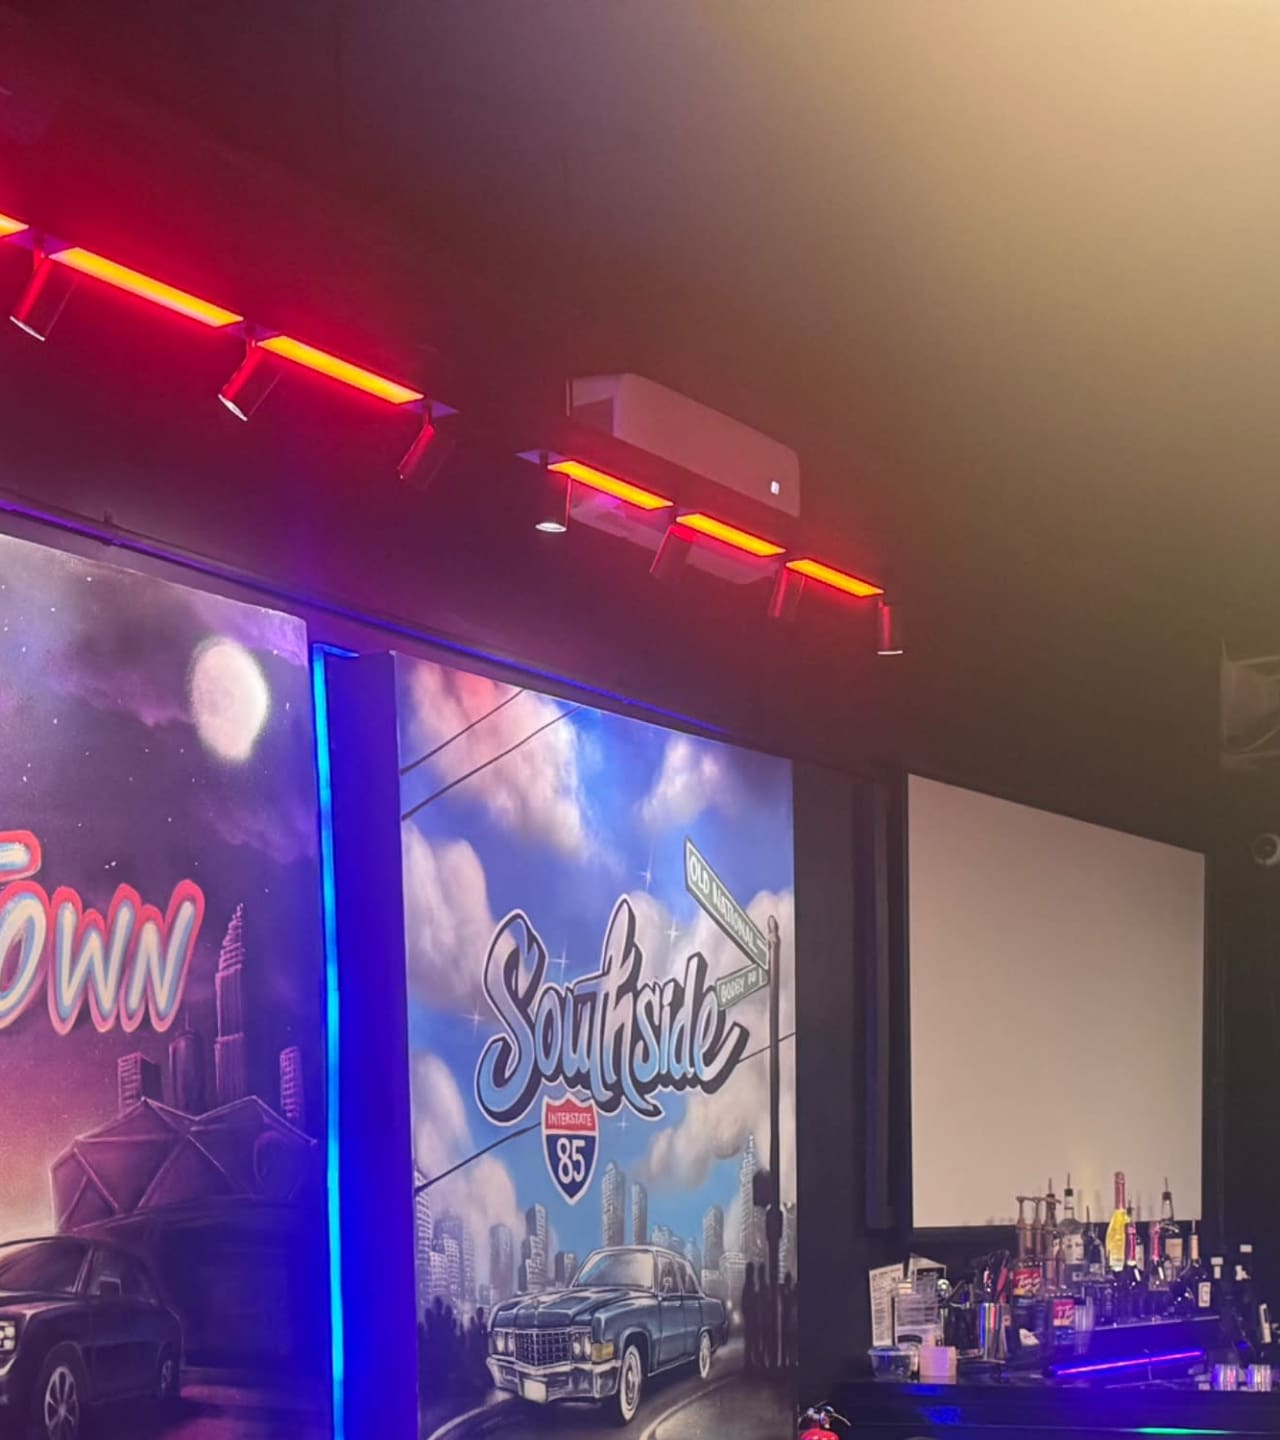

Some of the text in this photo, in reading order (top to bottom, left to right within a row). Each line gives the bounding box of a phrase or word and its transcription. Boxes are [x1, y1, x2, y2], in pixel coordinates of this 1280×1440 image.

[689, 856, 710, 894] OLD
[474, 894, 750, 1126] Southside
[548, 1112, 593, 1127] INTERSTATE
[557, 1137, 586, 1184] 85
